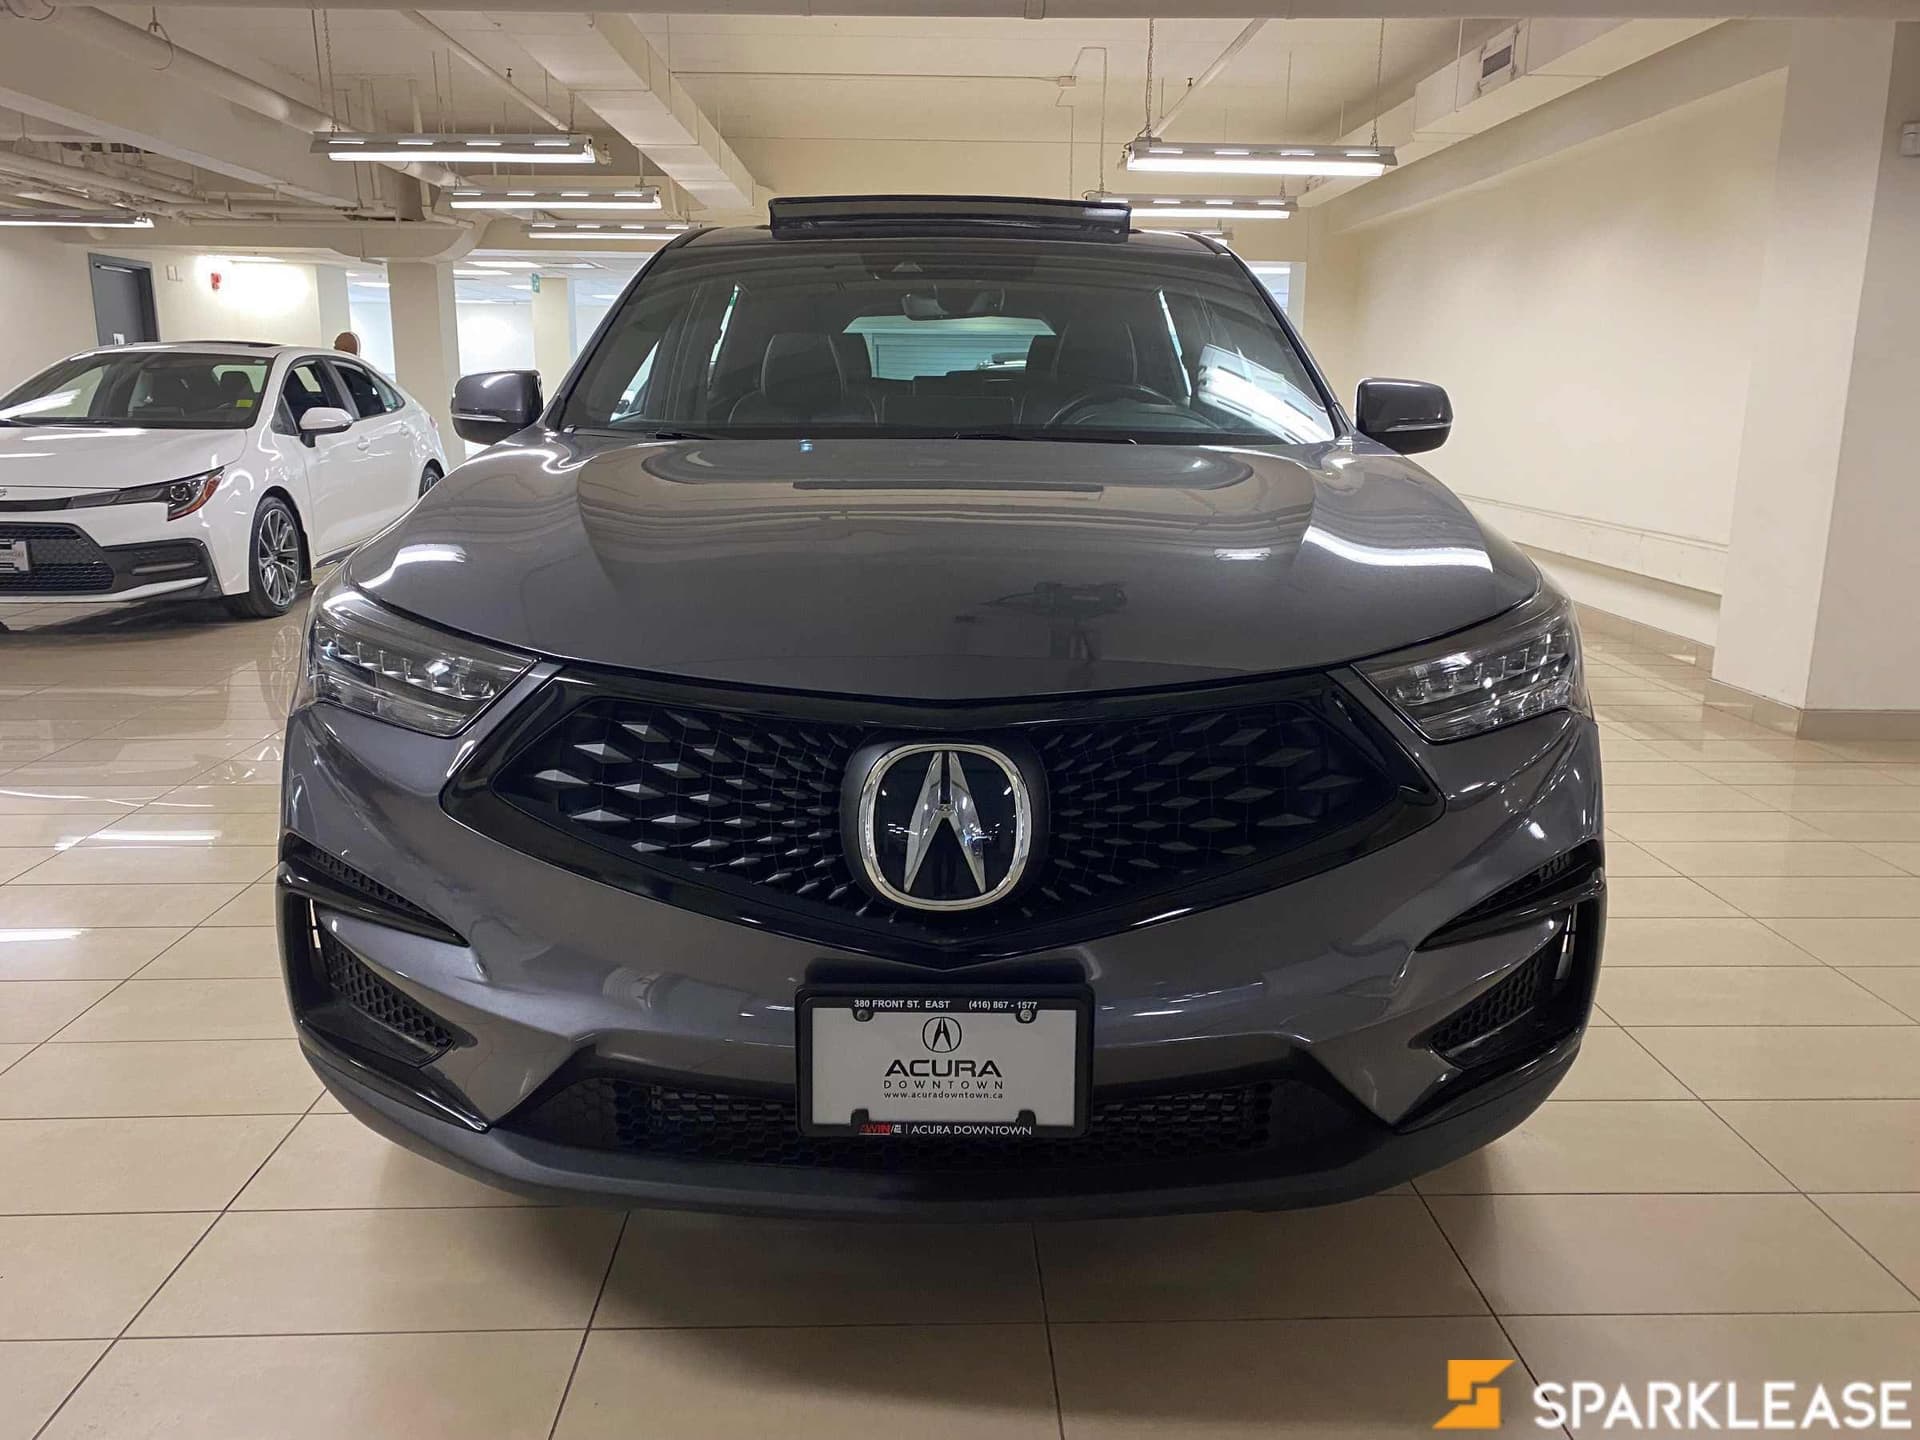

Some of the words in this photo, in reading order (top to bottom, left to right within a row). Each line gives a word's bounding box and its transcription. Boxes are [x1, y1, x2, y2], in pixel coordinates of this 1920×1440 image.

[854, 999, 870, 1008] 380
[872, 999, 904, 1009] FRONT
[907, 1000, 920, 1009] ST.
[925, 1000, 951, 1009] EAST
[968, 1000, 991, 1011] (416)
[993, 1001, 1009, 1009] 867
[1017, 1001, 1038, 1009] 1577
[884, 1059, 1002, 1078] ACURA
[883, 1080, 1003, 1089] DOWNTOWN
[883, 1091, 1003, 1099] www.acuradowntown.ca
[911, 1125, 951, 1135] ACURA
[953, 1125, 1032, 1136] DOWNTOWN
